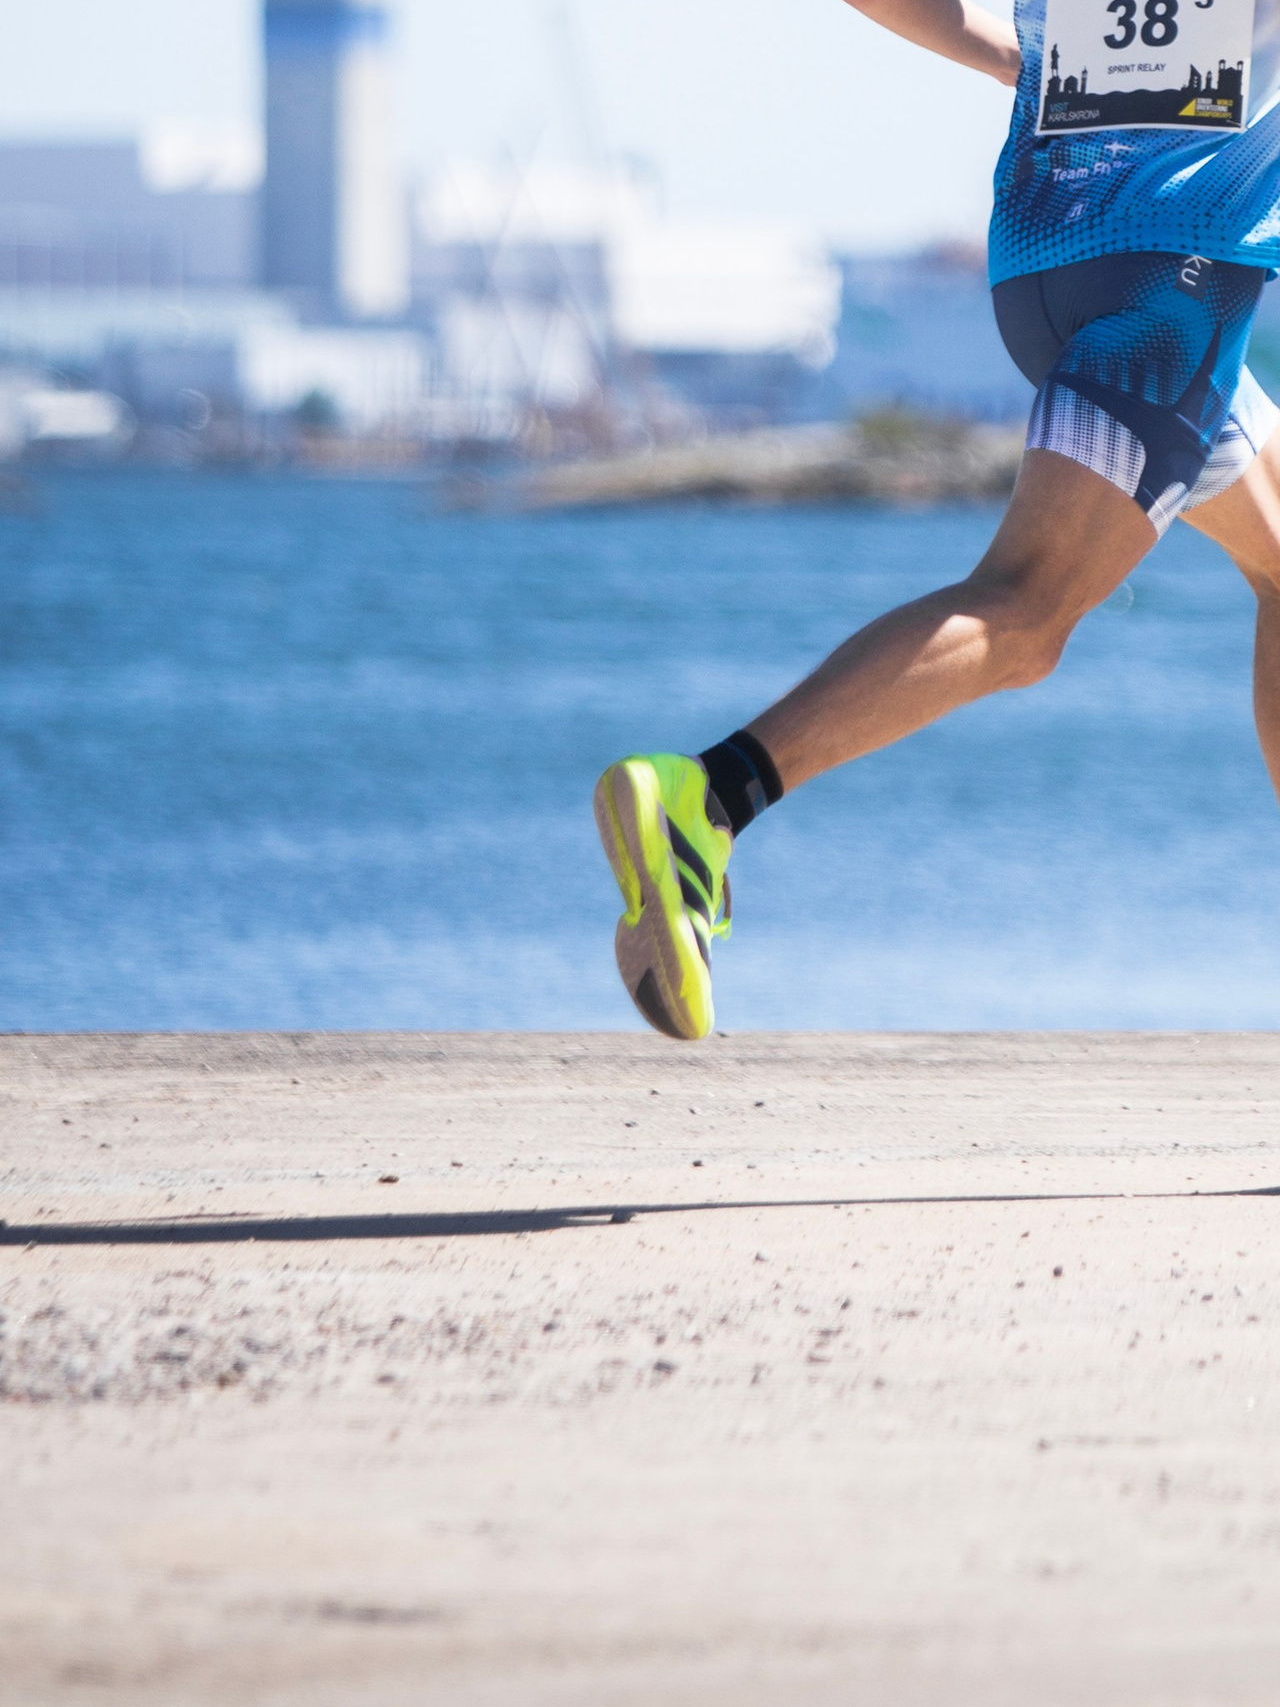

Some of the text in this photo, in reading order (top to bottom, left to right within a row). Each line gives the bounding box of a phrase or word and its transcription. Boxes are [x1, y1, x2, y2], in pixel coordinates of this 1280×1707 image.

[1107, 63, 1167, 75] SPRINT RELAY
[1052, 167, 1089, 182] Team
